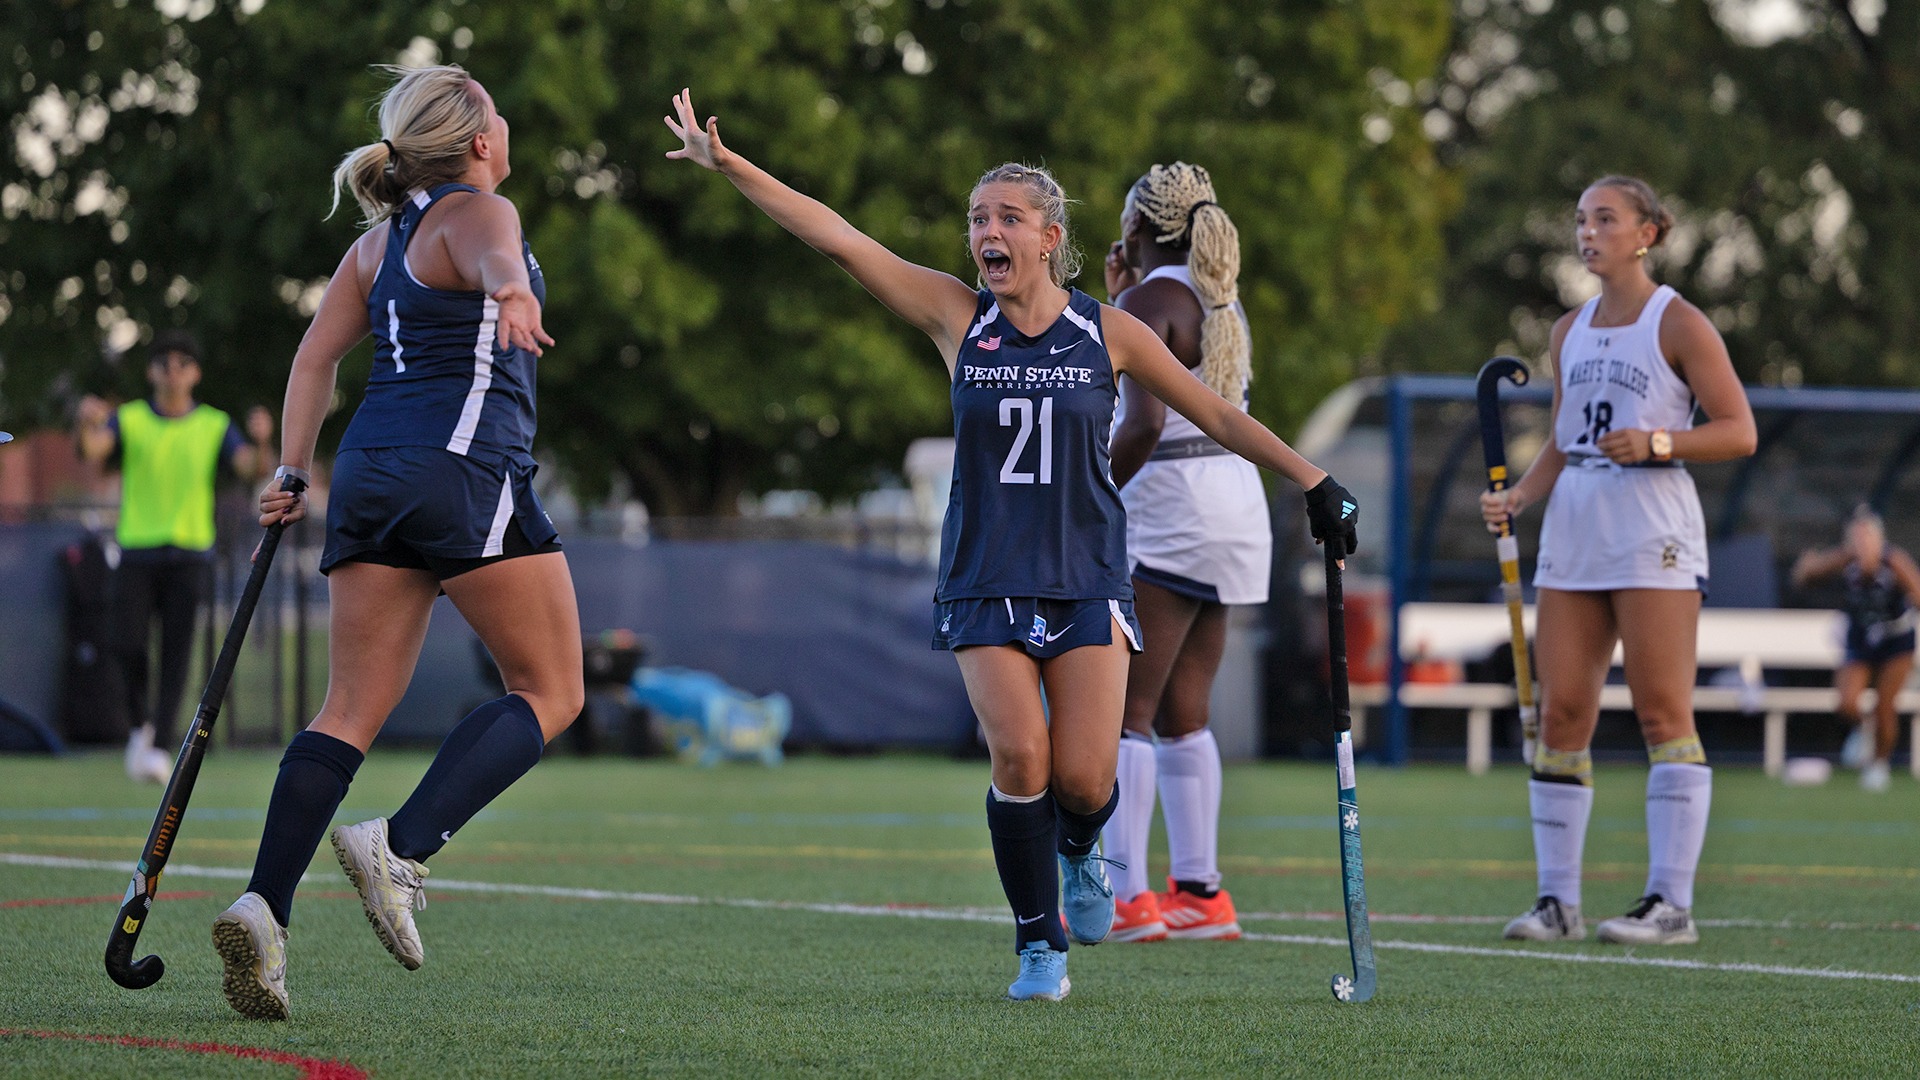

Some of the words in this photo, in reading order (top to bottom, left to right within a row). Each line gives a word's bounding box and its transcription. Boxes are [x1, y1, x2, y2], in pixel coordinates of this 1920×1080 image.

[387, 299, 406, 374] 1
[963, 365, 1020, 382] PENN
[1025, 366, 1093, 384] STATE
[975, 381, 1076, 390] HARRISBURG
[1608, 358, 1650, 400] COLLEGE
[998, 396, 1053, 484] 21
[1576, 401, 1613, 445] 18
[152, 804, 179, 857] ritual
